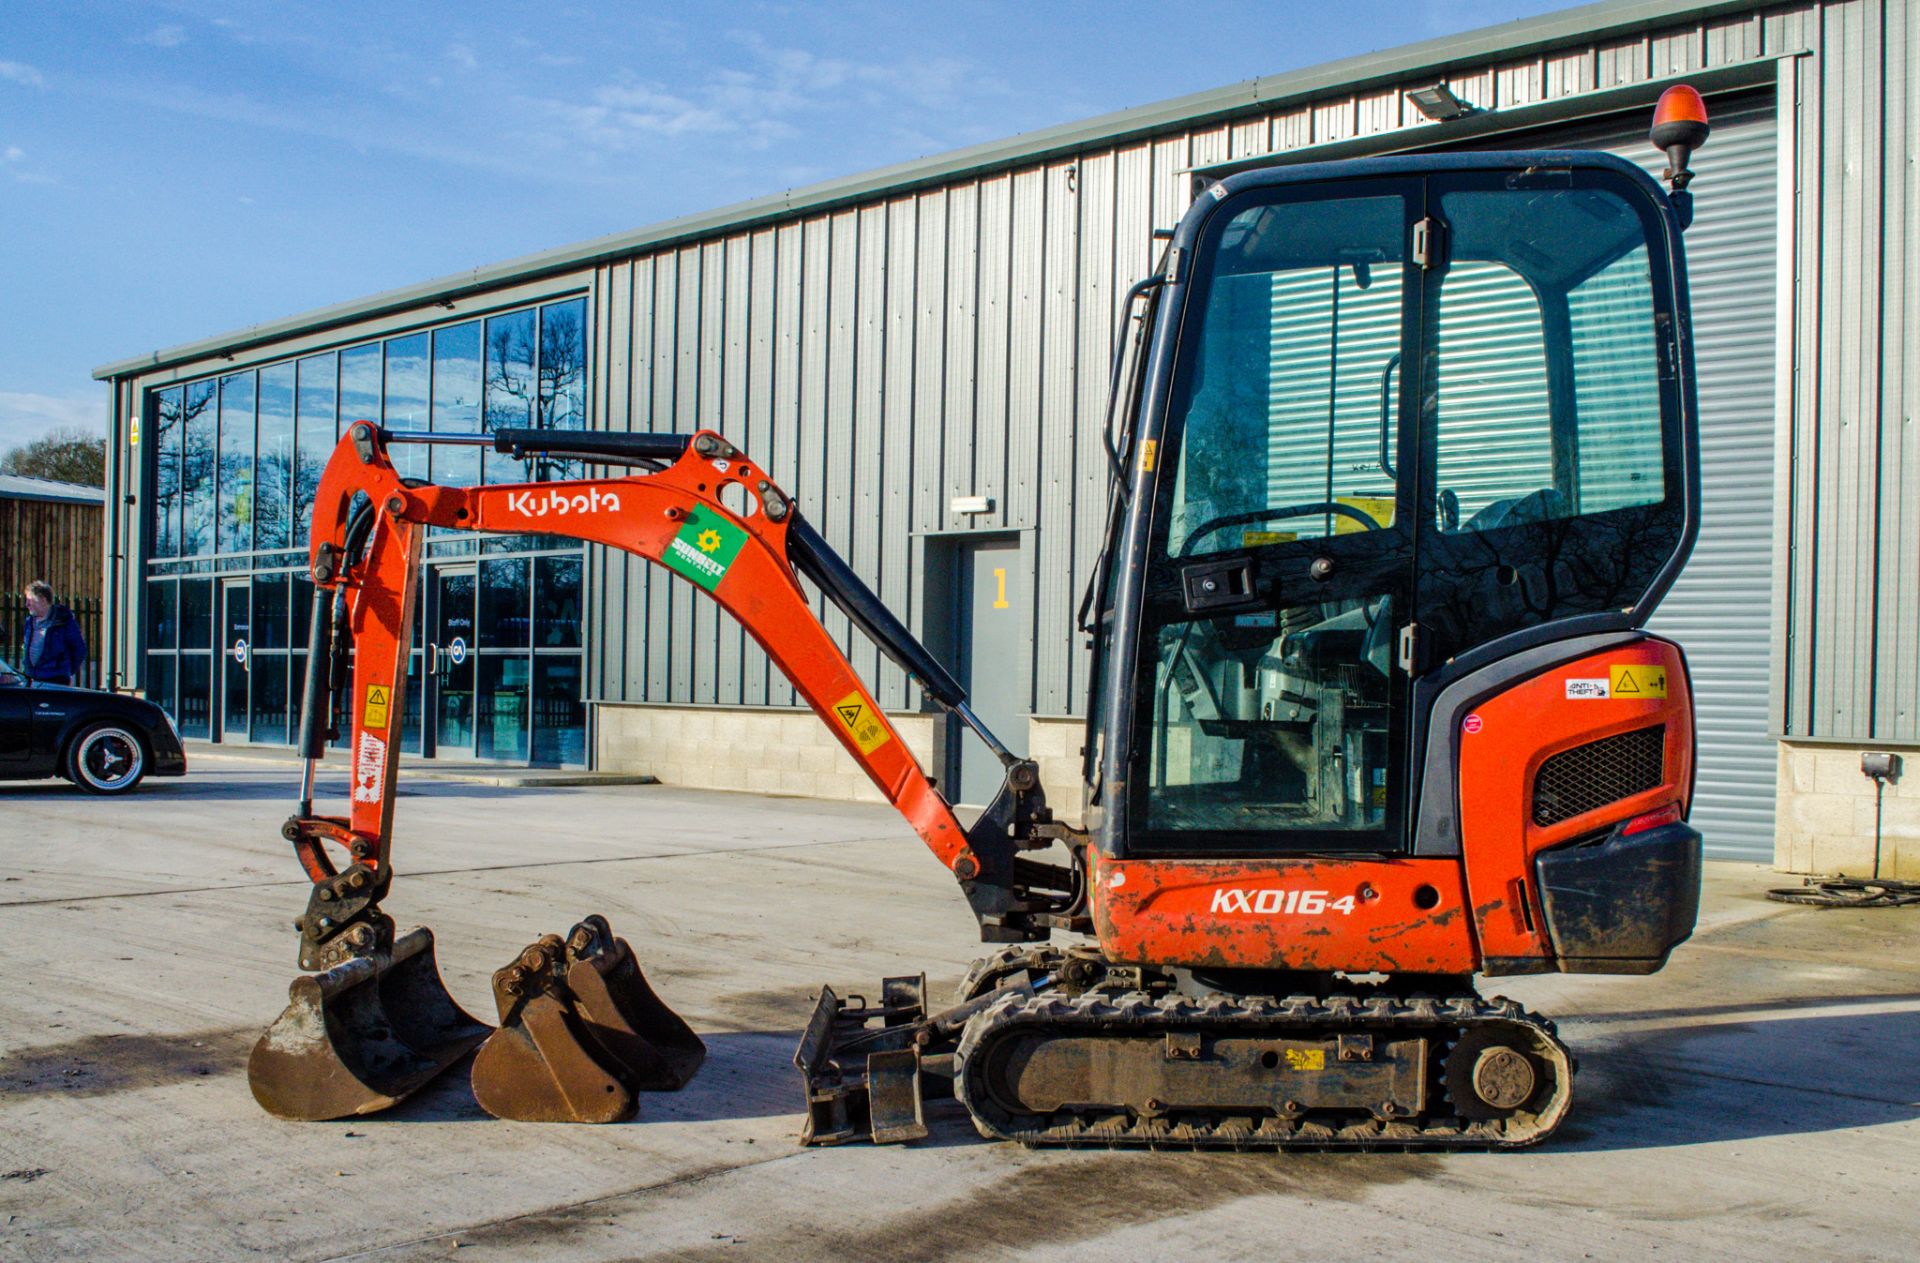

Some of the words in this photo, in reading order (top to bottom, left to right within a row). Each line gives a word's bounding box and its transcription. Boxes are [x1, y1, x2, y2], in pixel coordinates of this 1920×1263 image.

[508, 488, 620, 517] Kubota
[671, 537, 726, 576] SUNBELT
[675, 550, 713, 576] RENTALS
[993, 568, 1008, 608] 1
[1210, 888, 1356, 915] KX016-4
